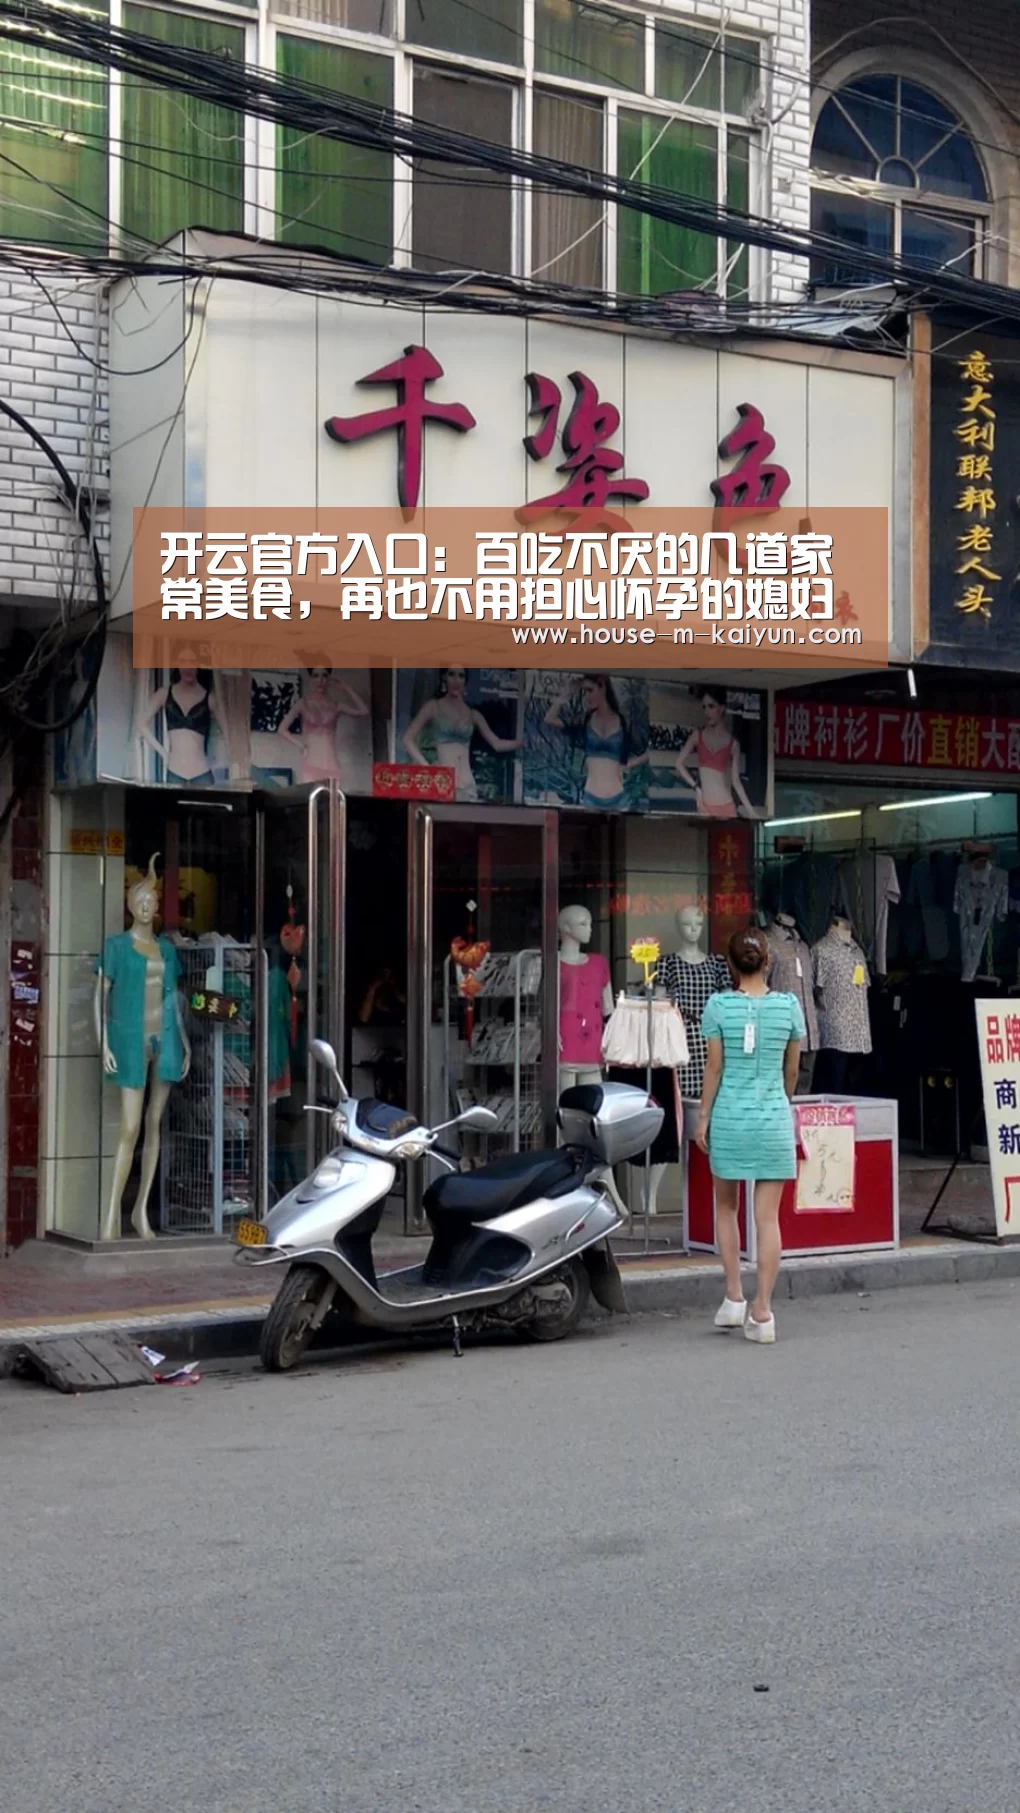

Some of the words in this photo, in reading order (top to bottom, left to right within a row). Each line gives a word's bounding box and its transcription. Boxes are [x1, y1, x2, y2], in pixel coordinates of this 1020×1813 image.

[954, 350, 1001, 620] 意大利联邦老人头
